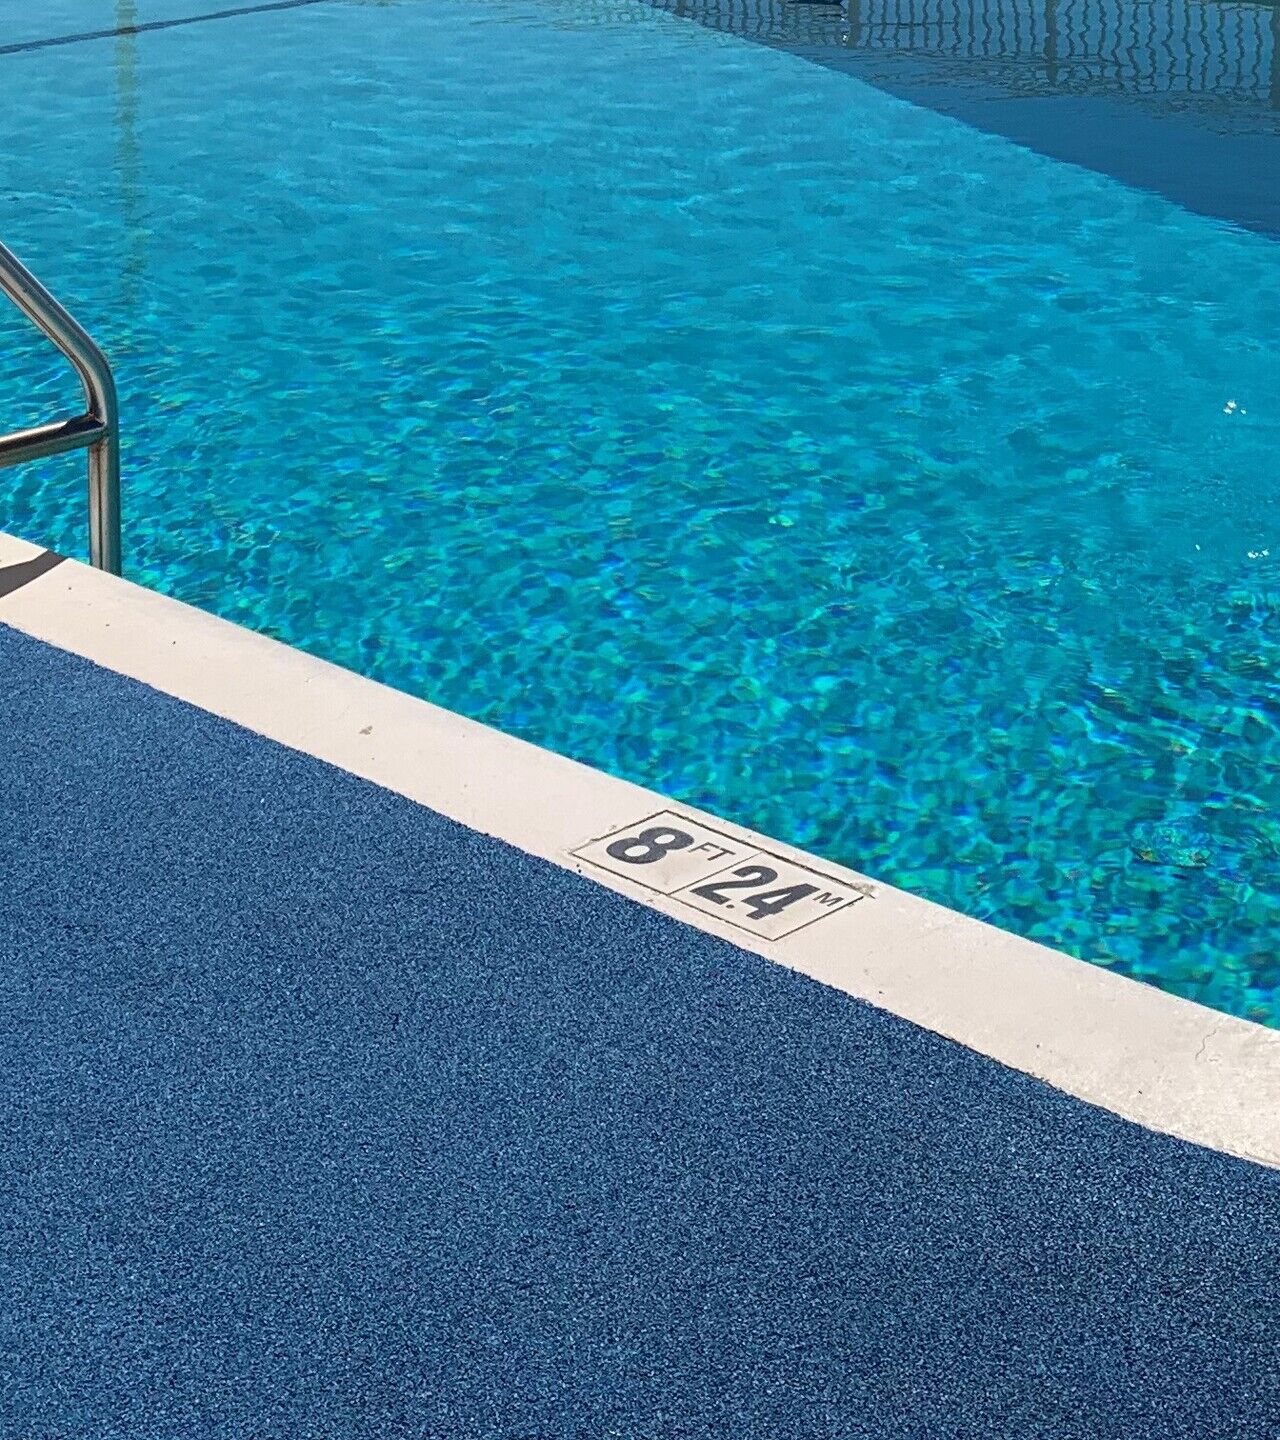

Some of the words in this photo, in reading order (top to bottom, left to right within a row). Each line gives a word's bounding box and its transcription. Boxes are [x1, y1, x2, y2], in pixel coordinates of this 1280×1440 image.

[605, 826, 694, 864] 8
[688, 841, 736, 862] FT
[814, 891, 843, 908] M
